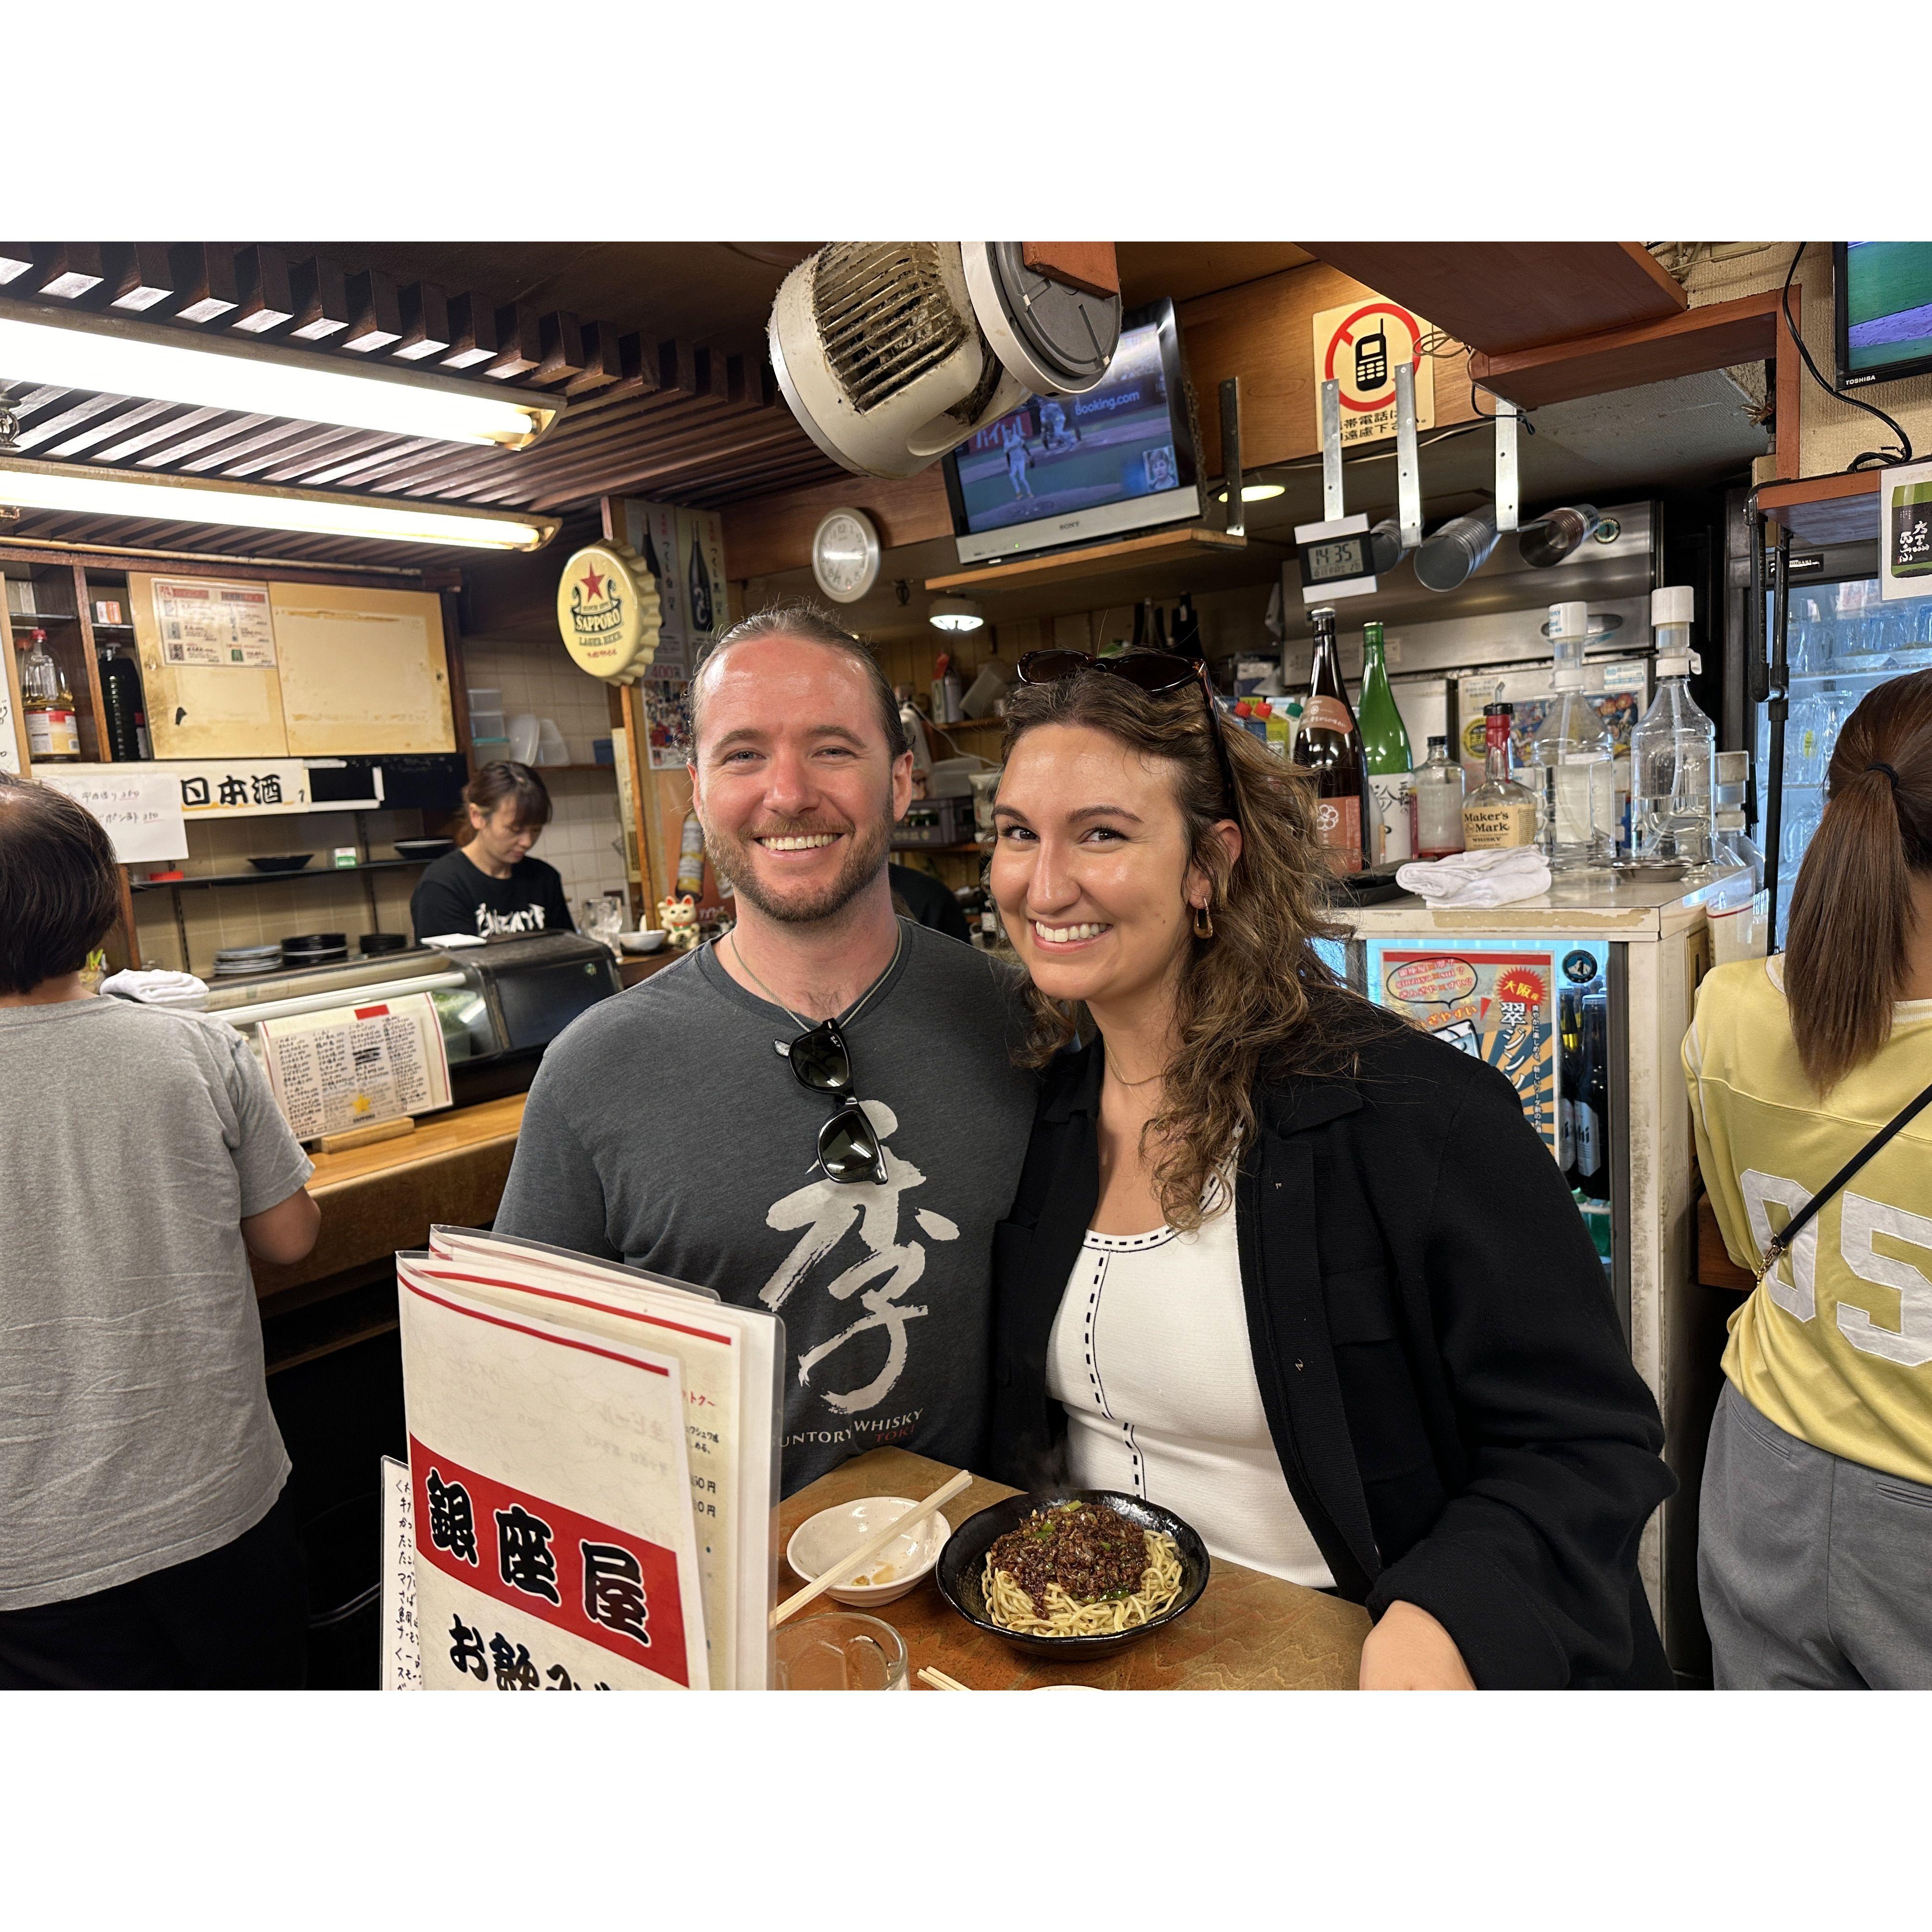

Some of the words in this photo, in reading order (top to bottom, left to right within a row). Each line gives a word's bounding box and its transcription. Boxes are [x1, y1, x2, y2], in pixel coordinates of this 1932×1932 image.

[1845, 375, 1876, 385] TOSHIBA
[1075, 390, 1140, 416] Booking.com
[1340, 410, 1397, 430] 帯電話は
[1058, 521, 1081, 530] SONY
[575, 608, 621, 632] SAPPORO
[180, 773, 283, 805] 日本酒
[1464, 812, 1509, 822] Maker's
[1474, 822, 1510, 833] Mark
[1503, 980, 1540, 1002] 大阪産
[770, 1425, 852, 1448] UNTORY
[854, 1407, 924, 1432] WHISKY
[874, 1425, 915, 1443] TOKI
[425, 1466, 652, 1647] 銀座屋
[398, 1572, 416, 1591] マグ
